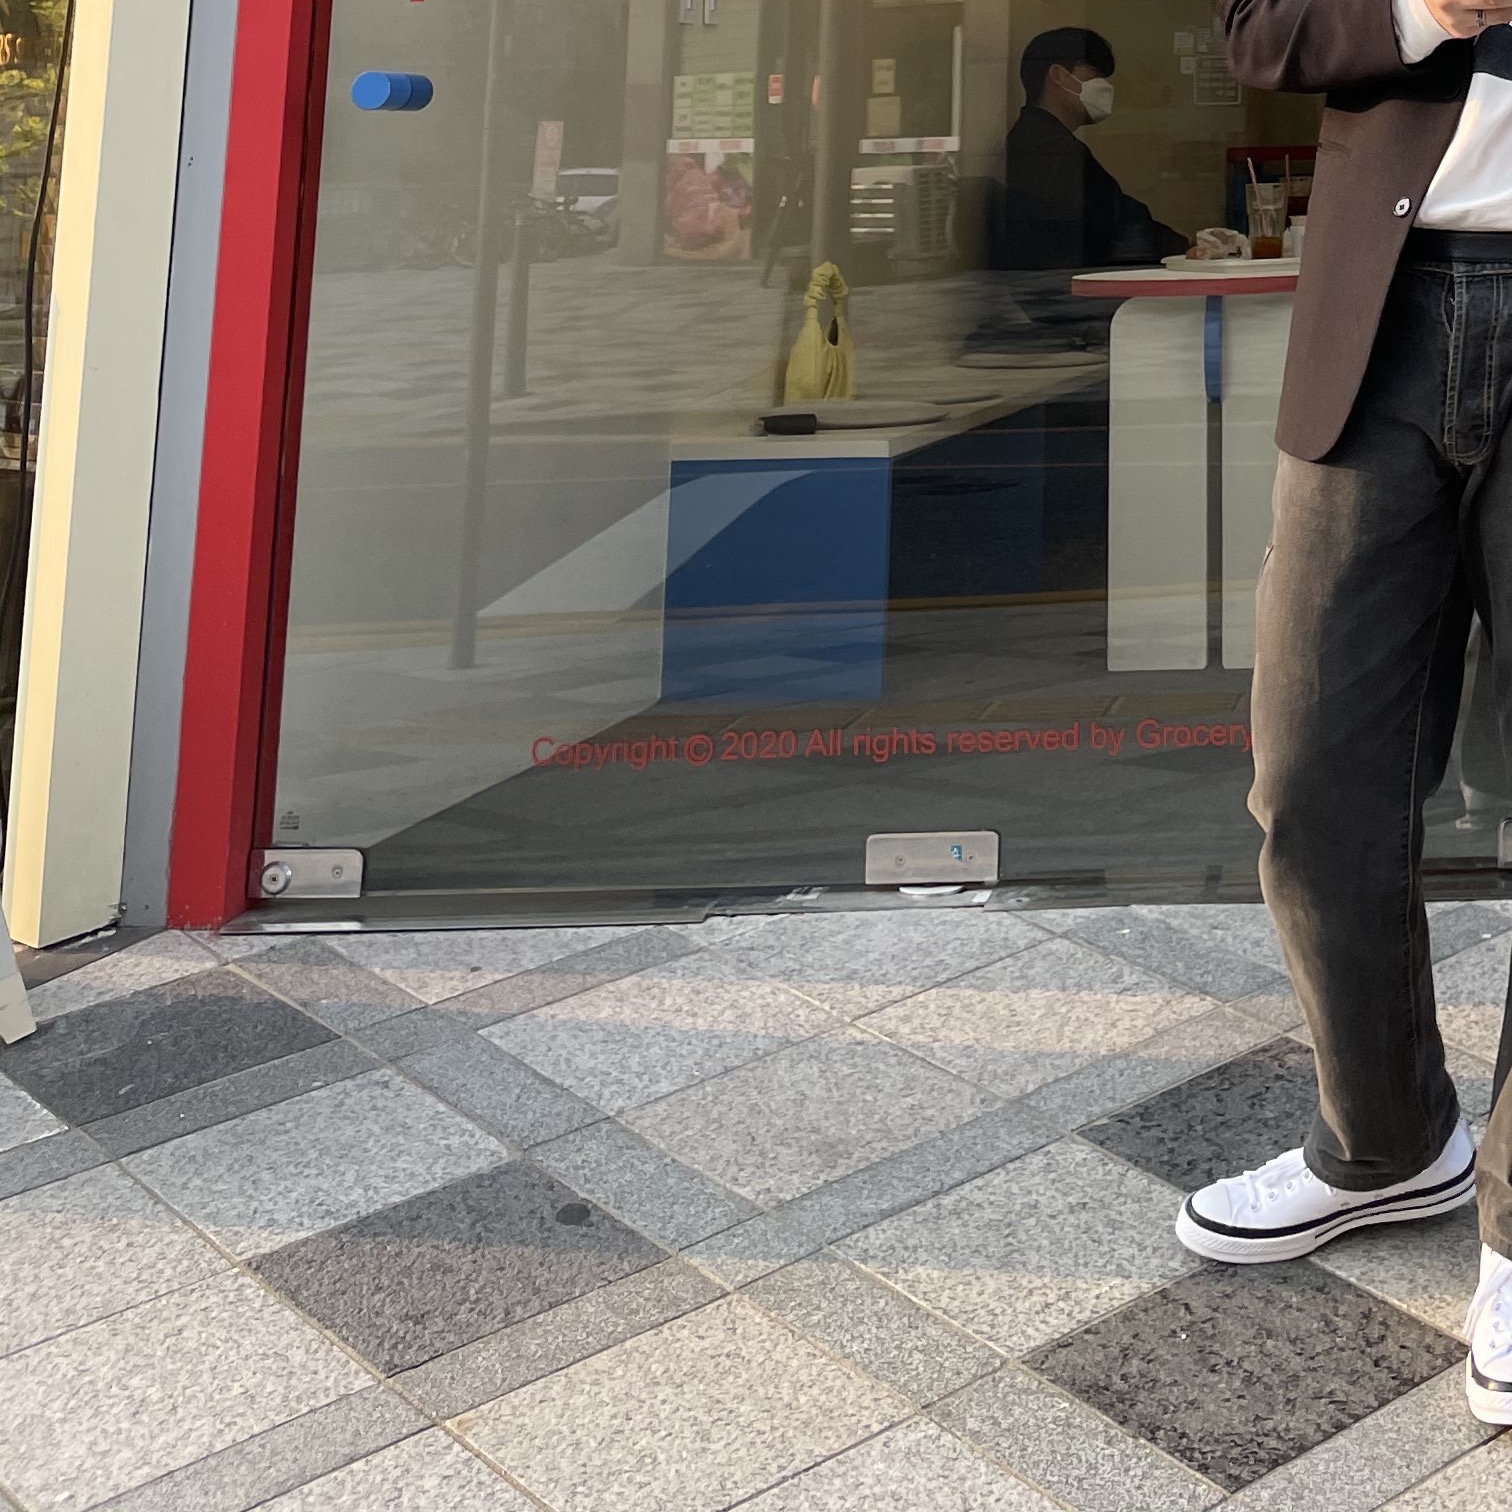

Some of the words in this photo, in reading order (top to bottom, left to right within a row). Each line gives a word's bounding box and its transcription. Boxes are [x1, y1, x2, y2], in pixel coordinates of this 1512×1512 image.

[532, 735, 679, 770] Copyright
[720, 730, 798, 761] 2020
[805, 728, 842, 757] All
[854, 727, 937, 763] rights
[947, 721, 1080, 754] reserved
[1090, 720, 1126, 757] by
[1136, 718, 1251, 754] Grocery
